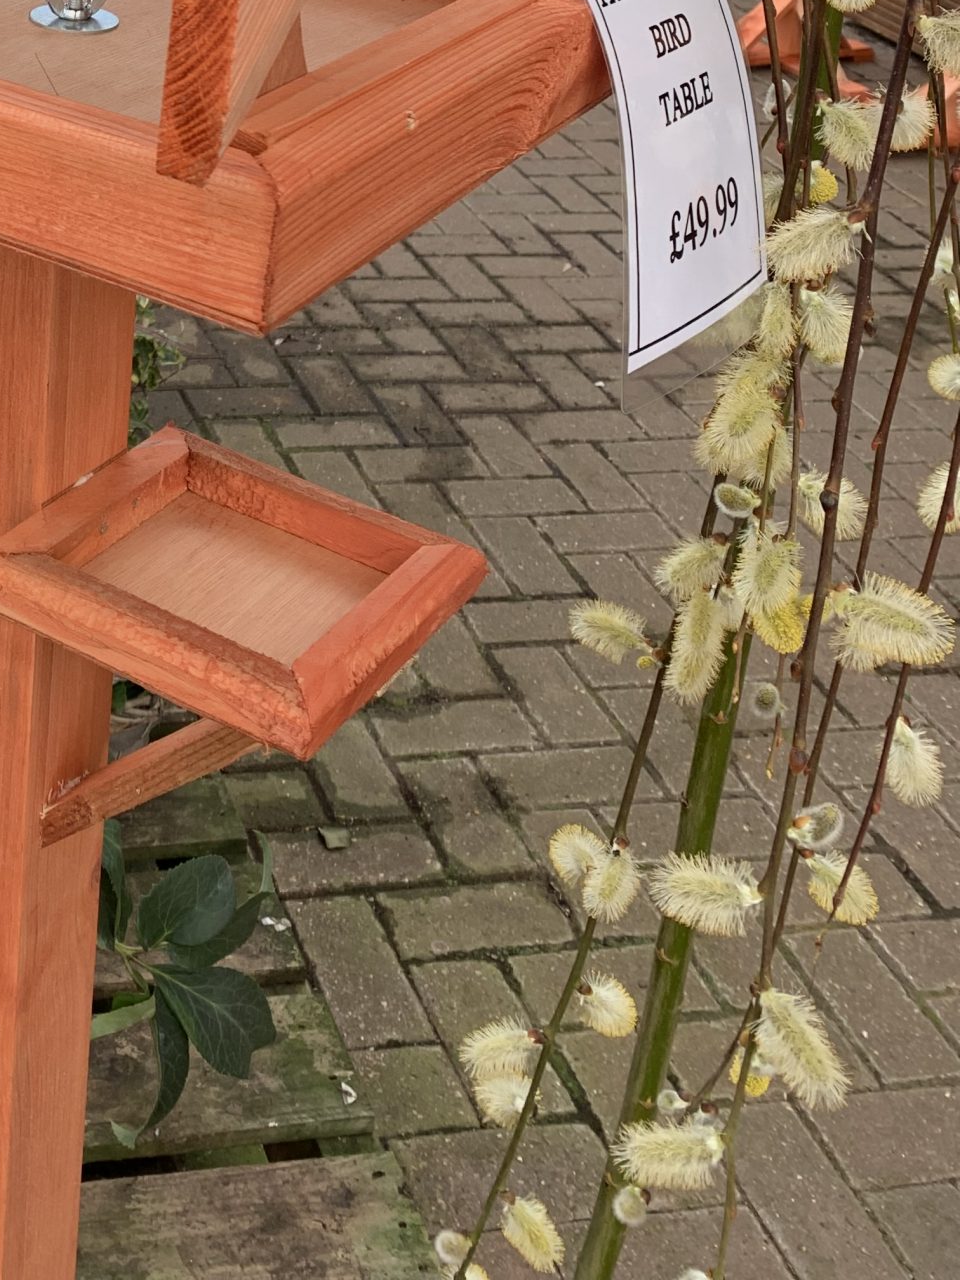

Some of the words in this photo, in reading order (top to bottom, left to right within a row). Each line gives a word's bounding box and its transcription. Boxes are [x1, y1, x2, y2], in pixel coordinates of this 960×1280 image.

[648, 13, 691, 58] BIRD
[658, 71, 713, 127] TABLE
[669, 177, 738, 264] £49.99
